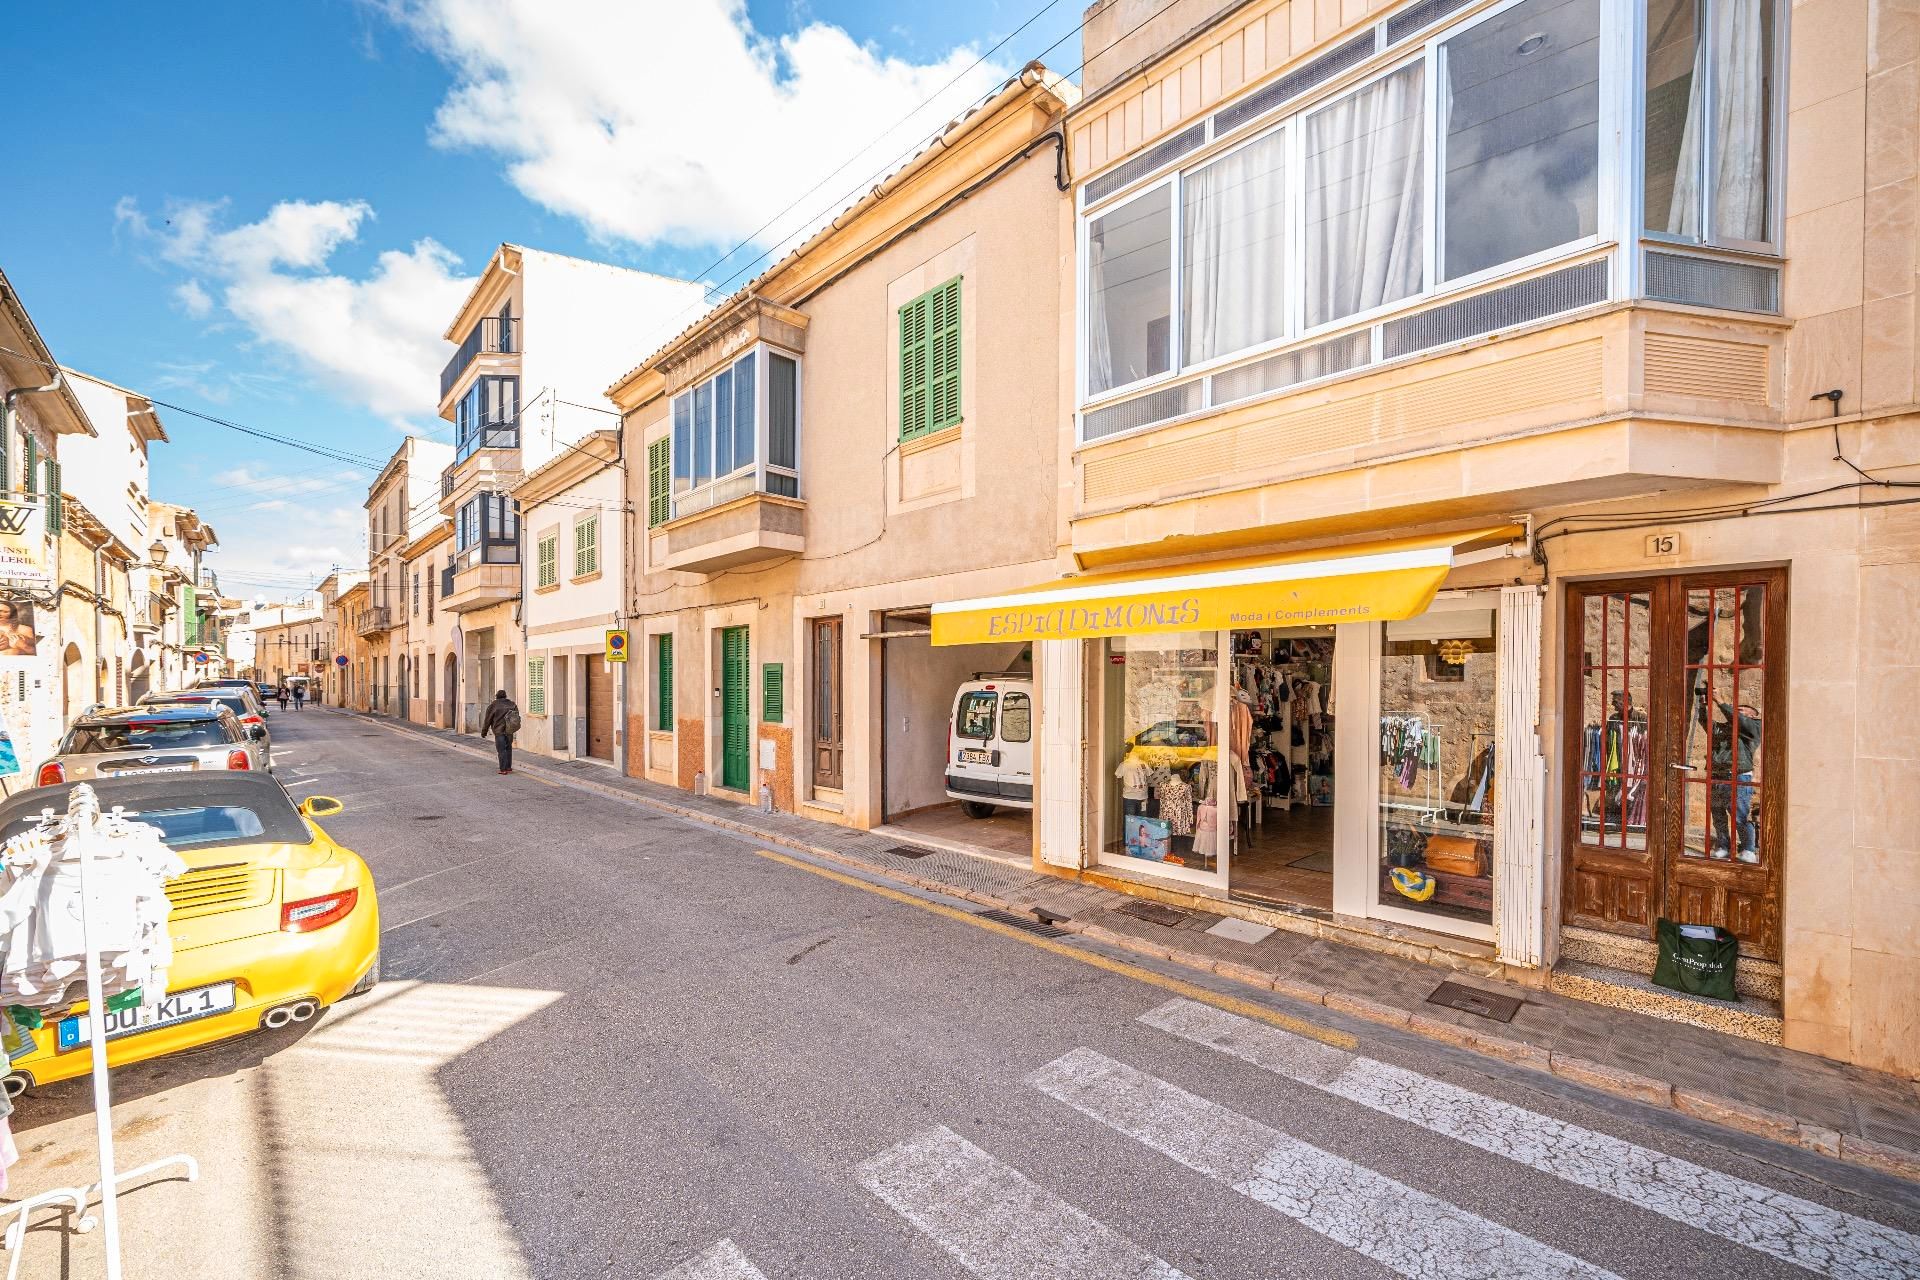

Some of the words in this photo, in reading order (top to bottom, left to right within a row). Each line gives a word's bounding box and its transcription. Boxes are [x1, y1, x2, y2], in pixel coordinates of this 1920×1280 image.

[1652, 535, 1673, 553] 15
[1230, 612, 1263, 623] Moda
[1275, 605, 1371, 621] Complements
[104, 1006, 137, 1033] DU
[157, 997, 193, 1021] KL
[199, 990, 214, 1011] 1
